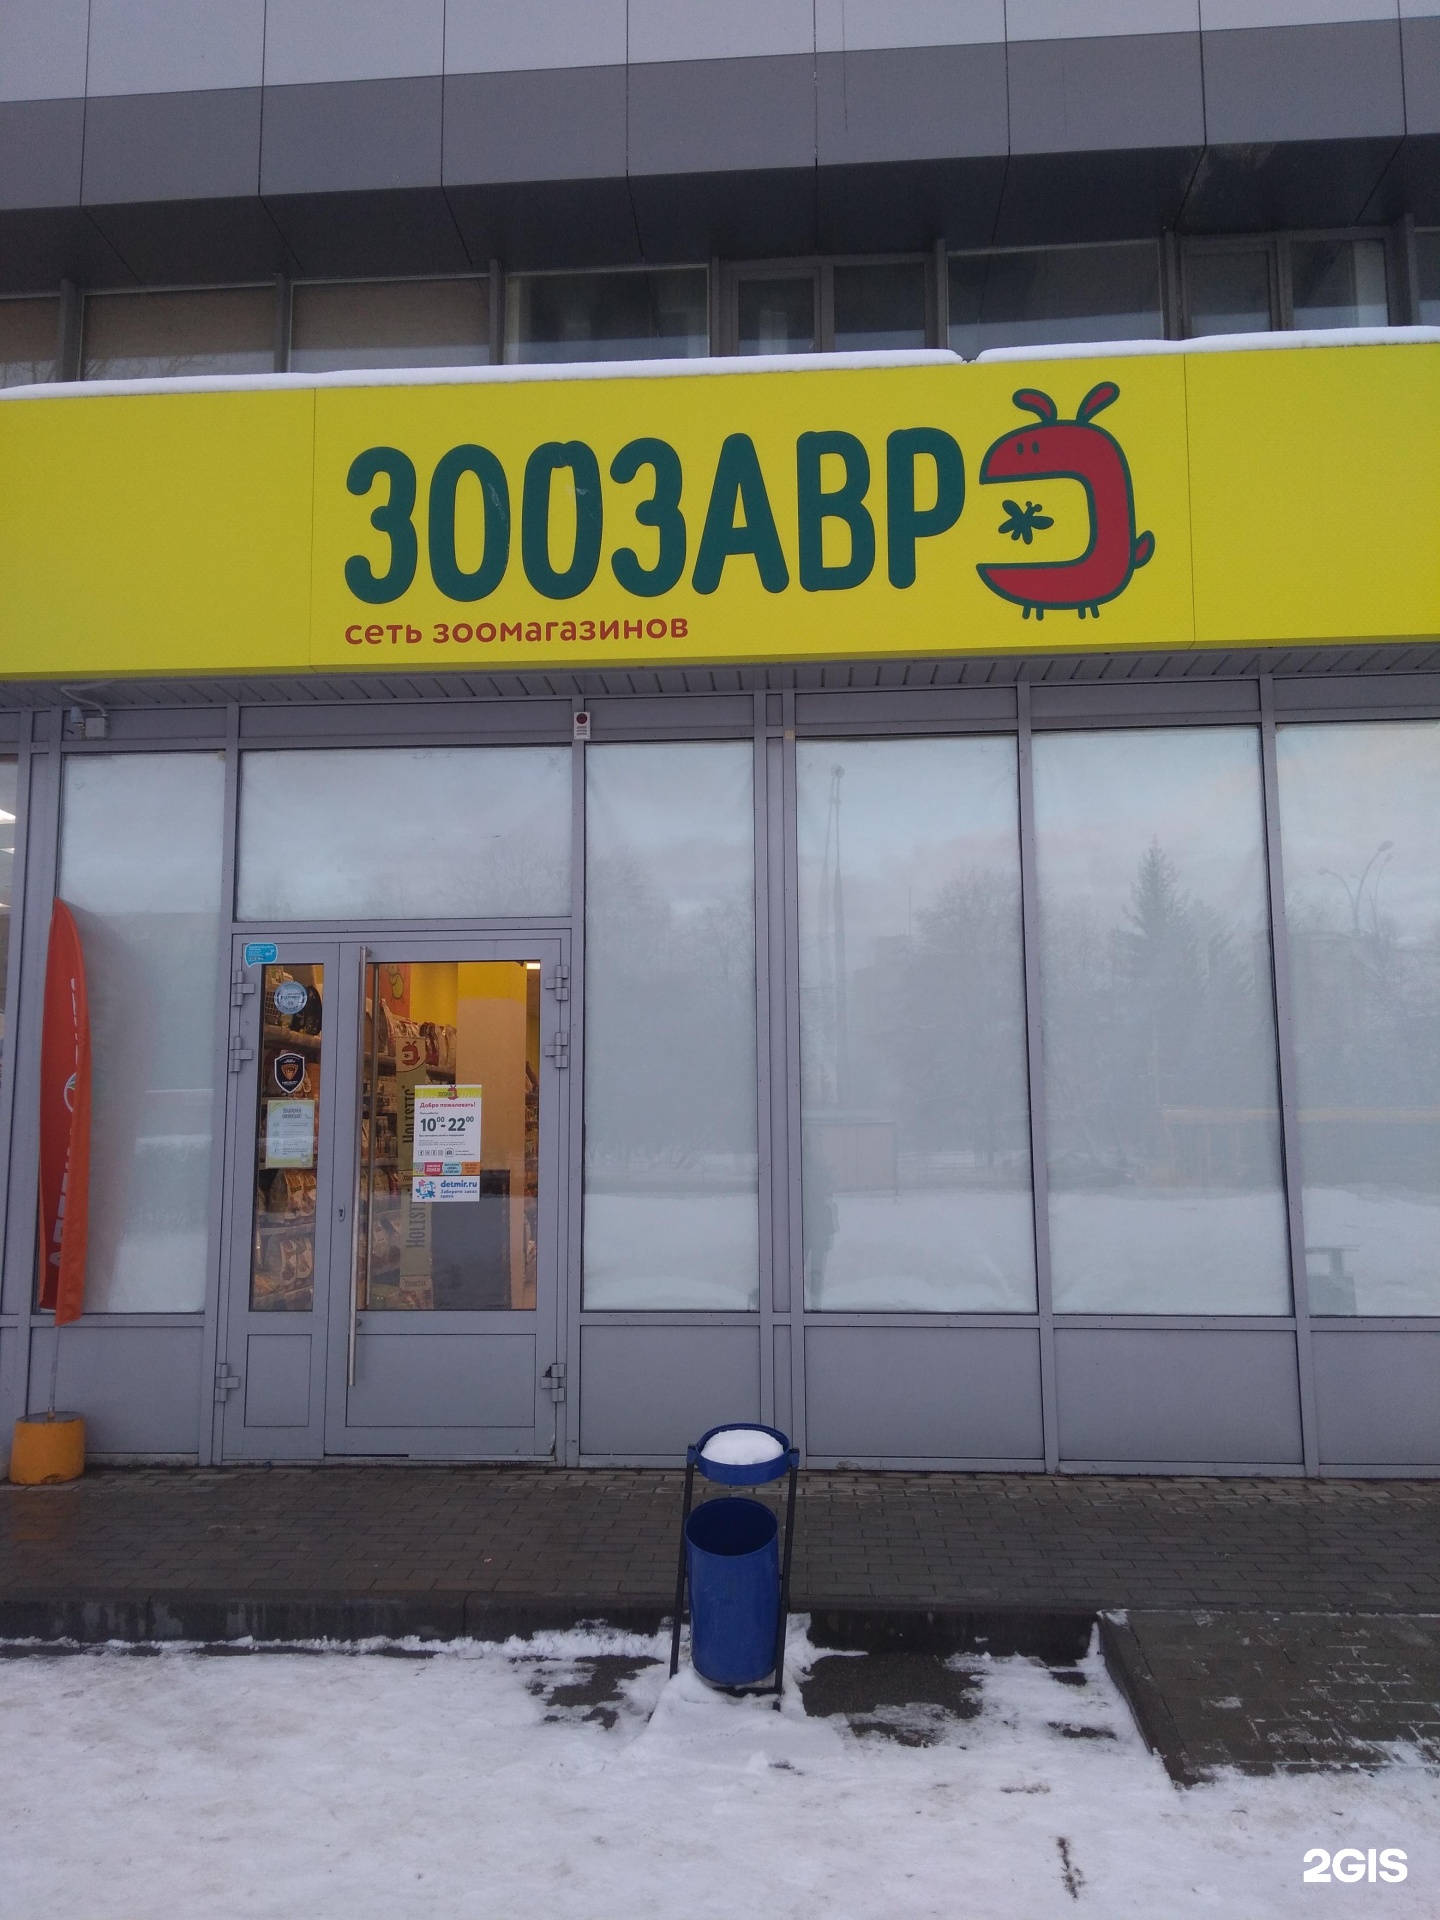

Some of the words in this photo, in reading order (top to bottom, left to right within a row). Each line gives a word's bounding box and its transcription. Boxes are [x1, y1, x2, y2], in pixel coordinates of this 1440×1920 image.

[344, 426, 966, 604] ЗООЗАВР
[344, 623, 423, 645] сеть
[432, 617, 689, 644] зоомагазинов
[440, 1179, 478, 1188] detmir.ru
